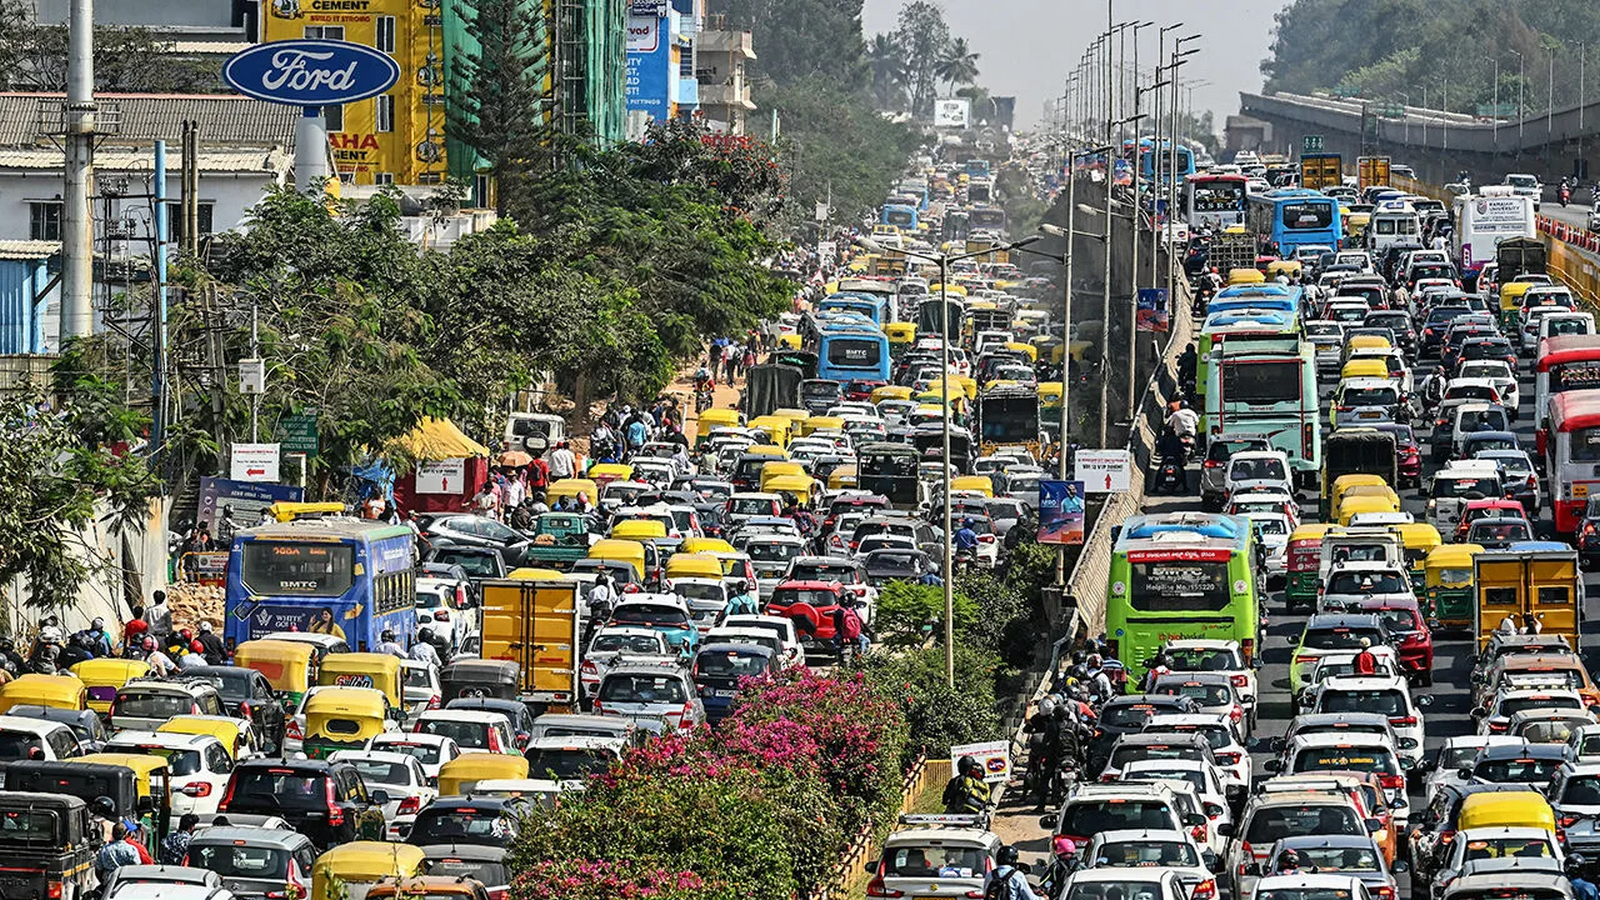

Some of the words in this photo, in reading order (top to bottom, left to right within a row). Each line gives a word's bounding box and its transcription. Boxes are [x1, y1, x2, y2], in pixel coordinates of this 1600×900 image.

[312, 0, 370, 10] CEMENT
[262, 49, 358, 91] Ford
[328, 133, 379, 150] AHA
[275, 614, 301, 622] WHITE
